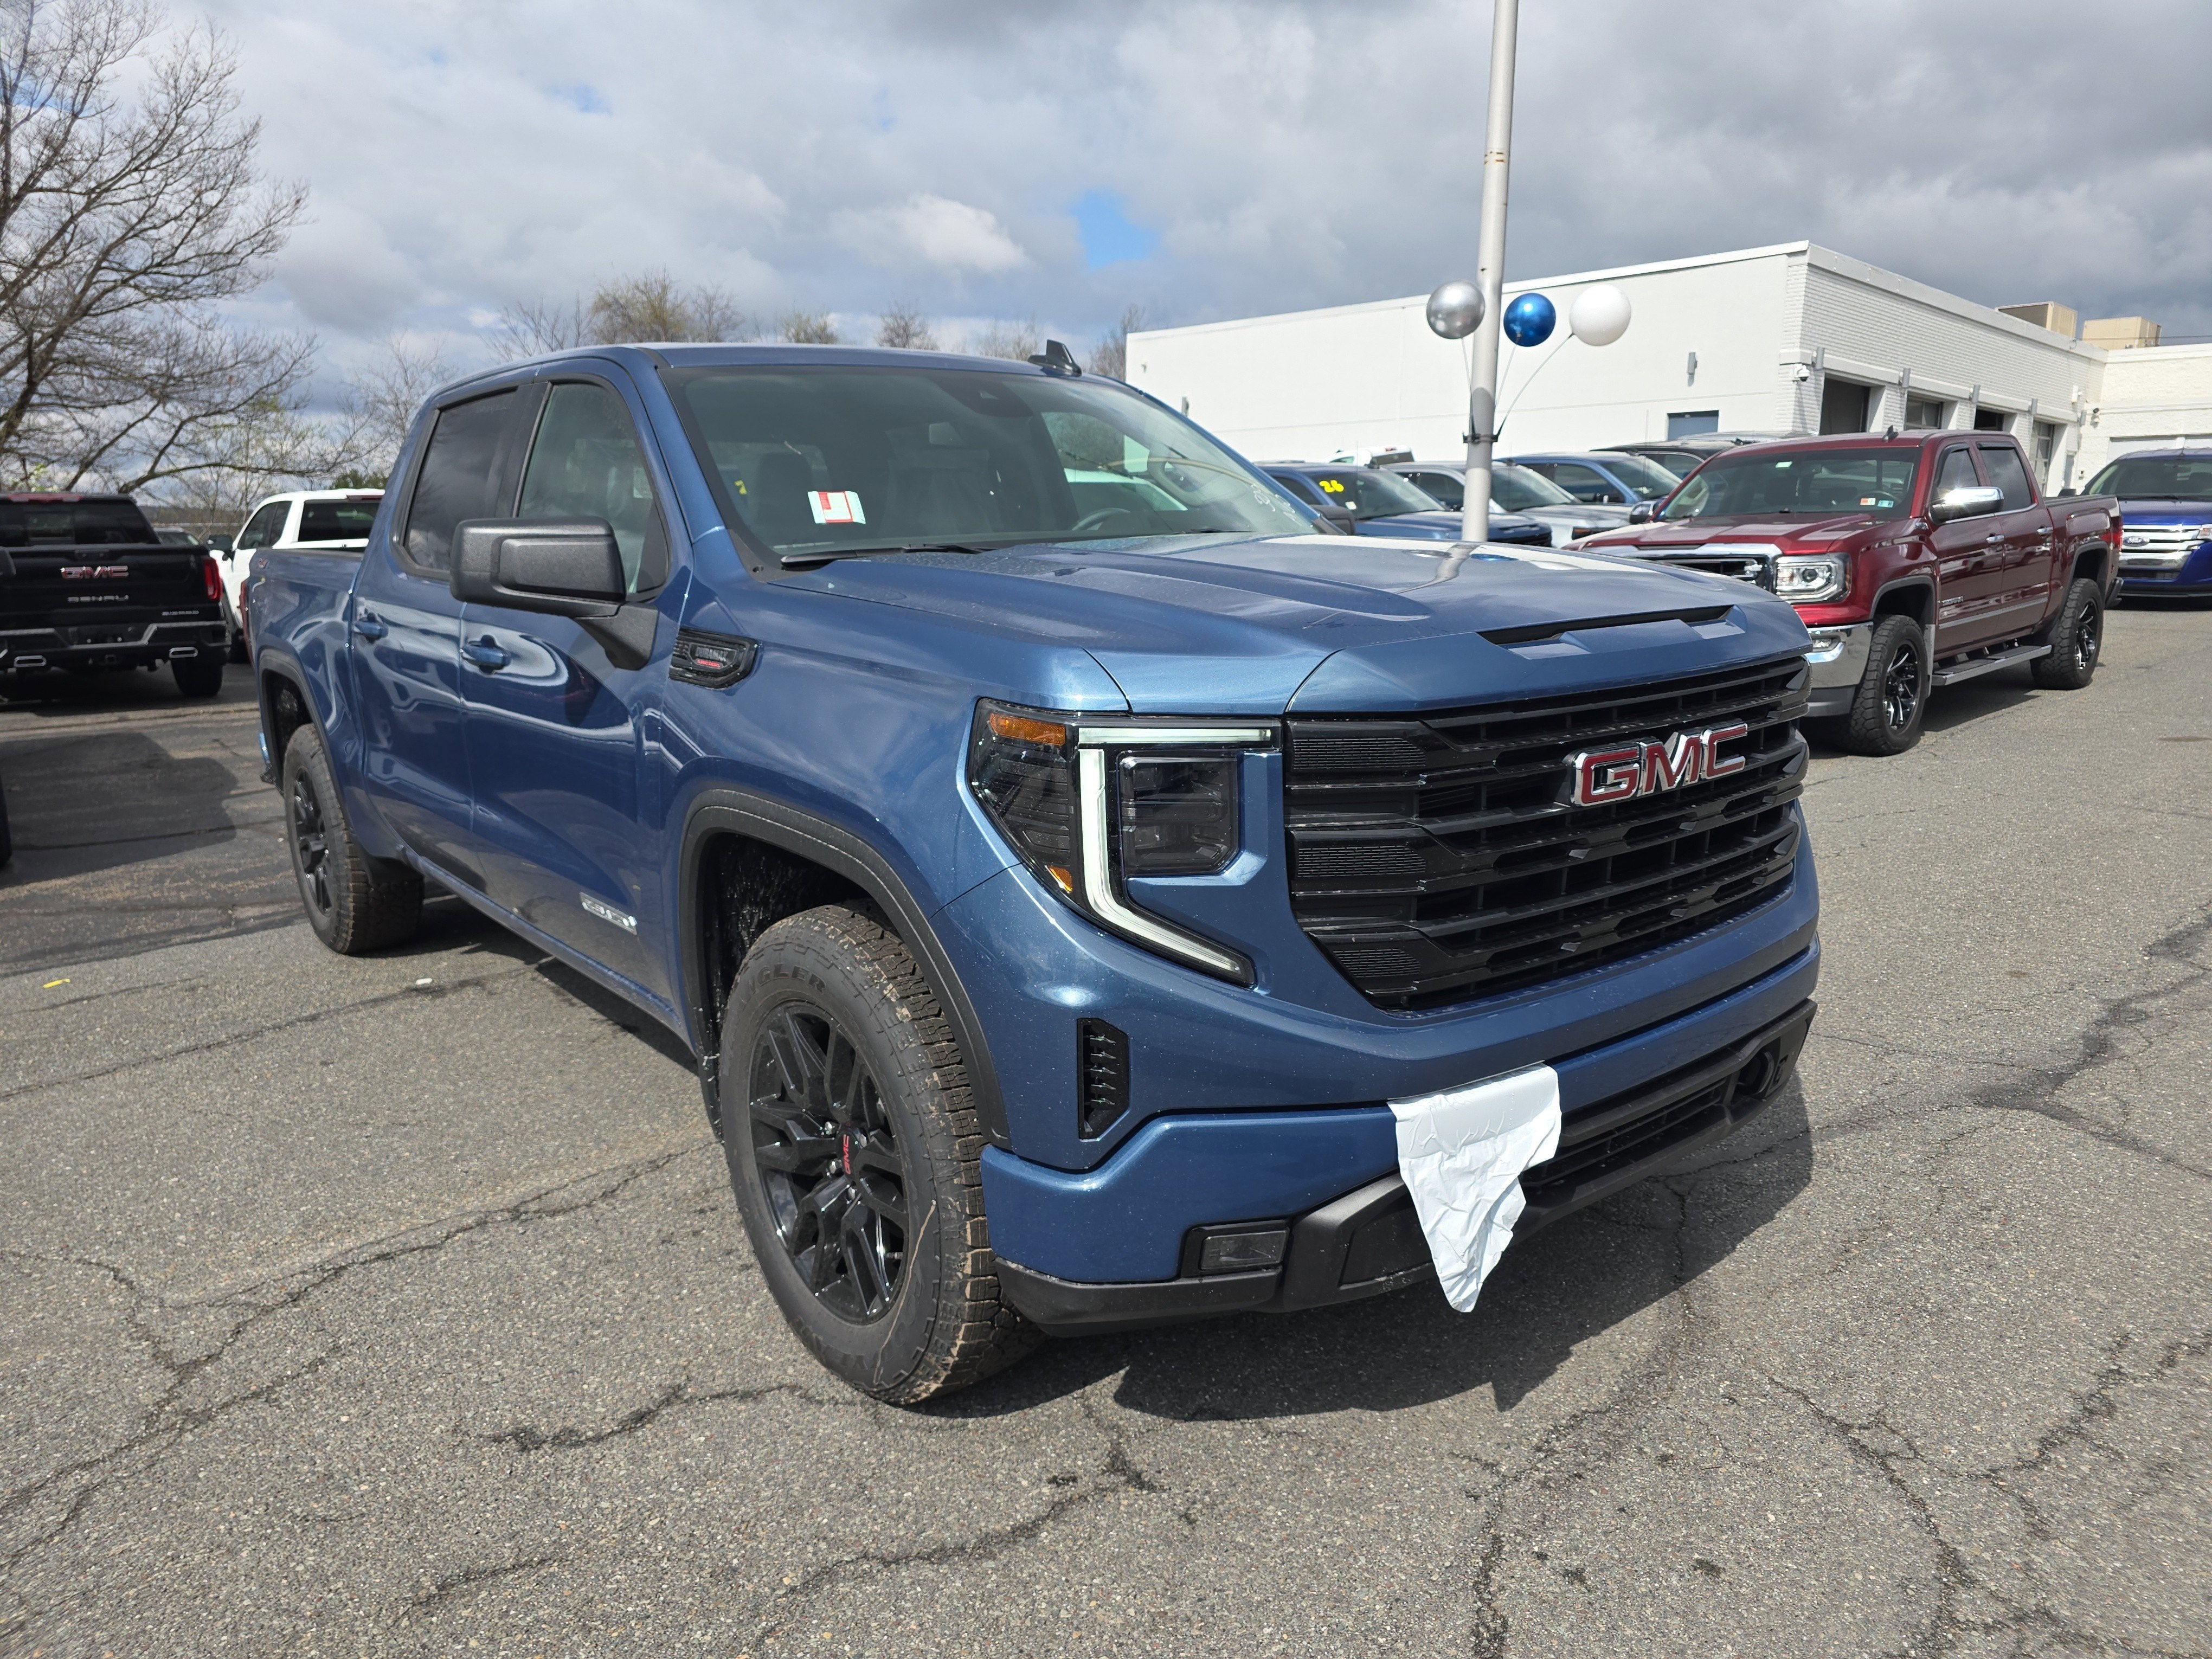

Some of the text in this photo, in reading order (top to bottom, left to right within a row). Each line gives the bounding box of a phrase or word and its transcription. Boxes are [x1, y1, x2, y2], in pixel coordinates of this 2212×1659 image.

[1319, 480, 1344, 493] 26
[61, 565, 128, 579] GMC
[1572, 723, 1748, 807] GMC
